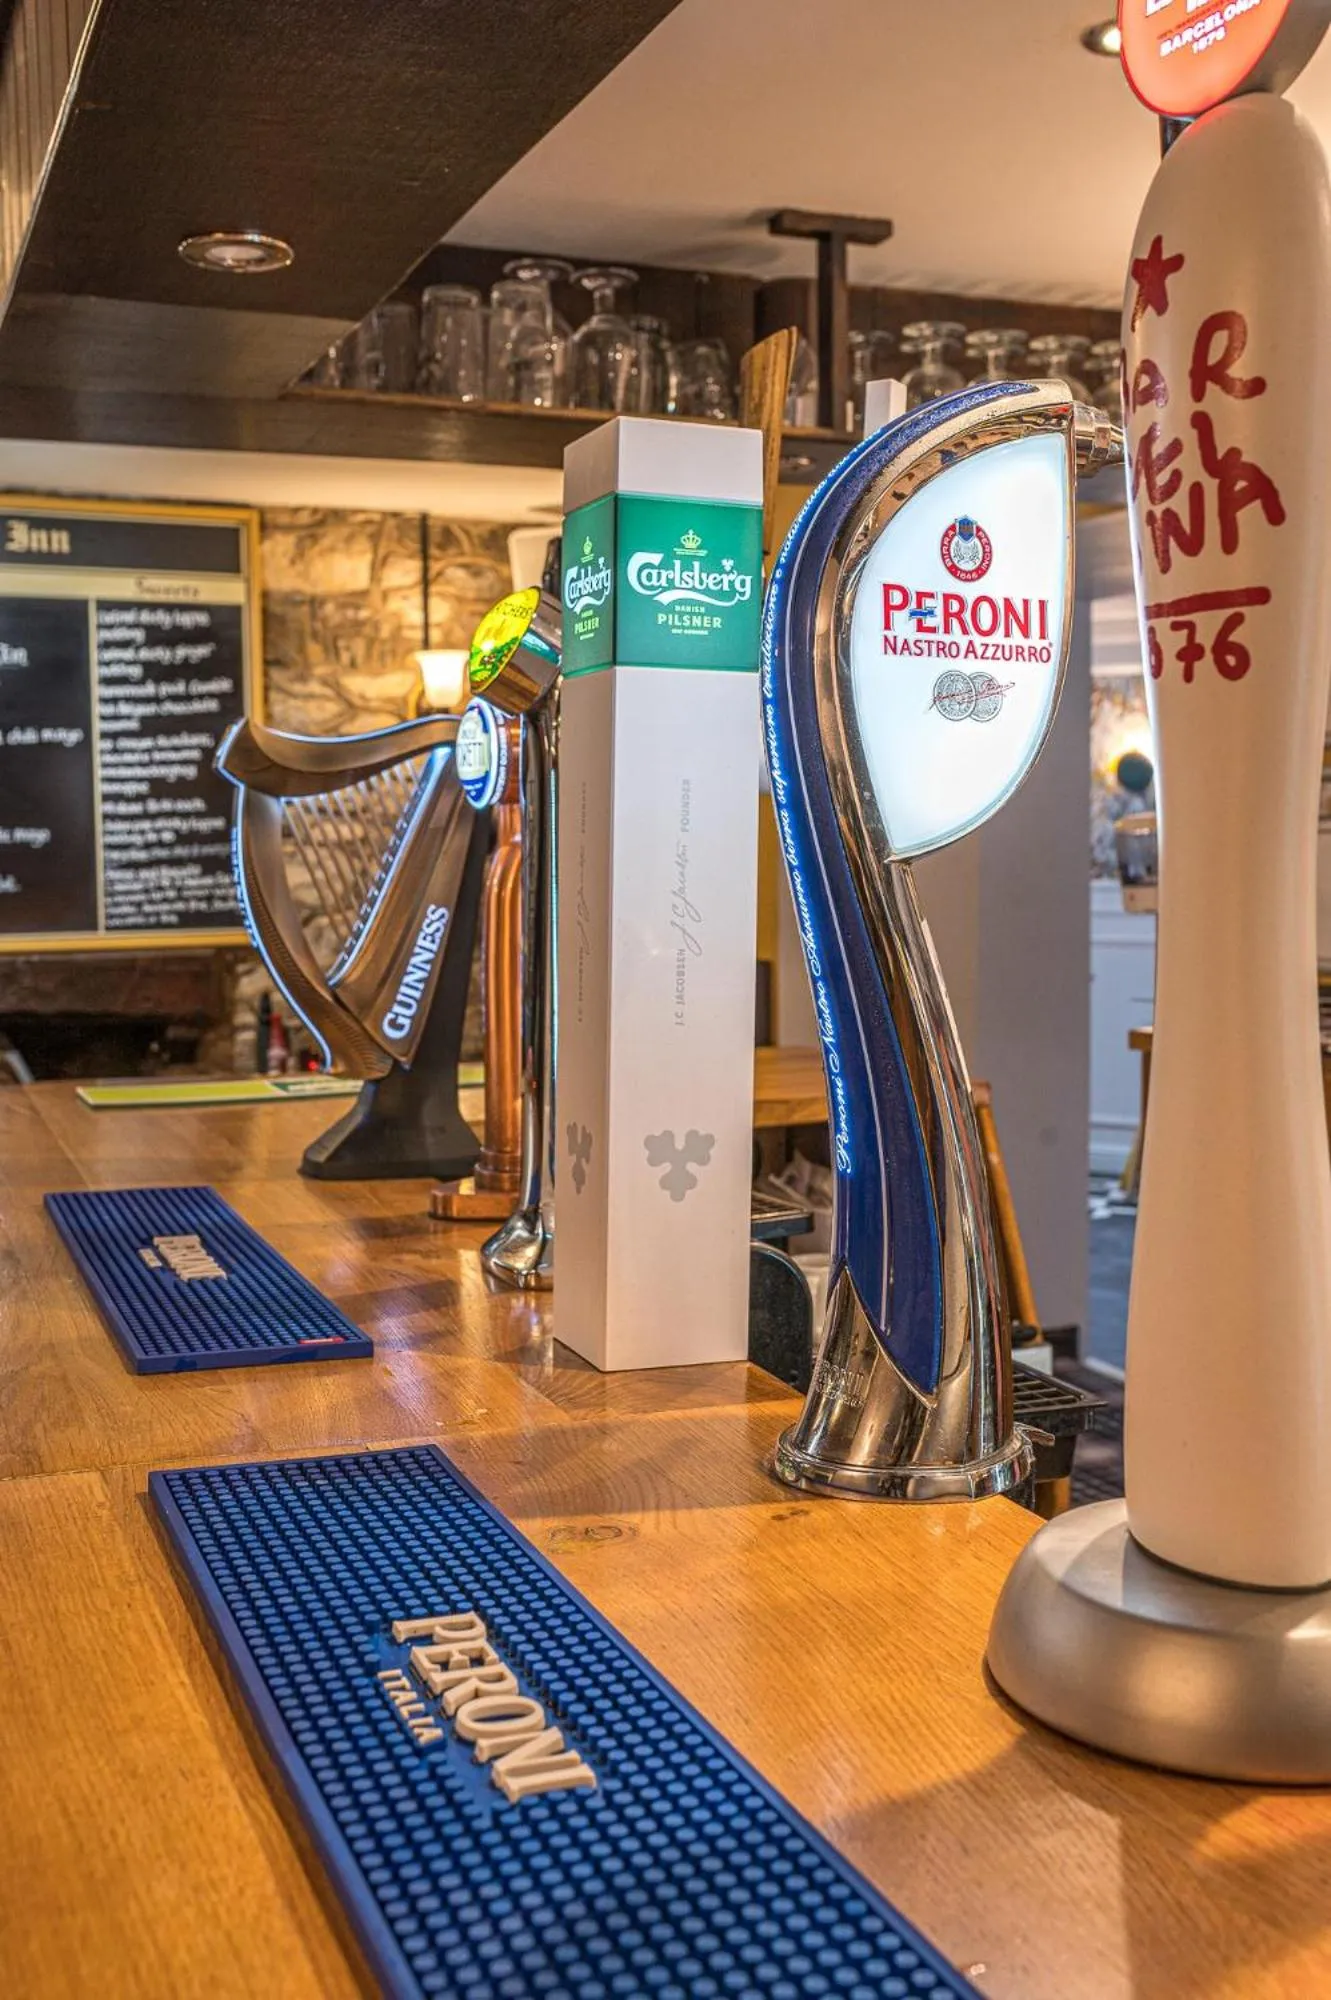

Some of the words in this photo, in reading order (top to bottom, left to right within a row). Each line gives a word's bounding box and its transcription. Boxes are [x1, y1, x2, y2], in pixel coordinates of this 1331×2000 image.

[5, 520, 71, 555] Inn
[943, 530, 957, 567] BIRRA
[977, 530, 992, 571] PERONI
[565, 560, 612, 613] Carlsberg
[627, 551, 753, 606] Carlsberg
[657, 613, 722, 628] PILSNER
[881, 583, 1050, 640] PERONI
[883, 636, 960, 659] NASTRO
[964, 640, 1051, 663] AZZURRO
[765, 703, 788, 804] superiore
[780, 808, 799, 866] birra
[675, 949, 686, 1005] JACOBSEN
[681, 778, 691, 833] FOUNDER
[382, 904, 449, 1039] GUINNESS
[816, 981, 840, 1073] Nastro
[831, 1074, 852, 1174] Peroni
[377, 1668, 443, 1746] ITALIA
[392, 1611, 597, 1804] PERONI
